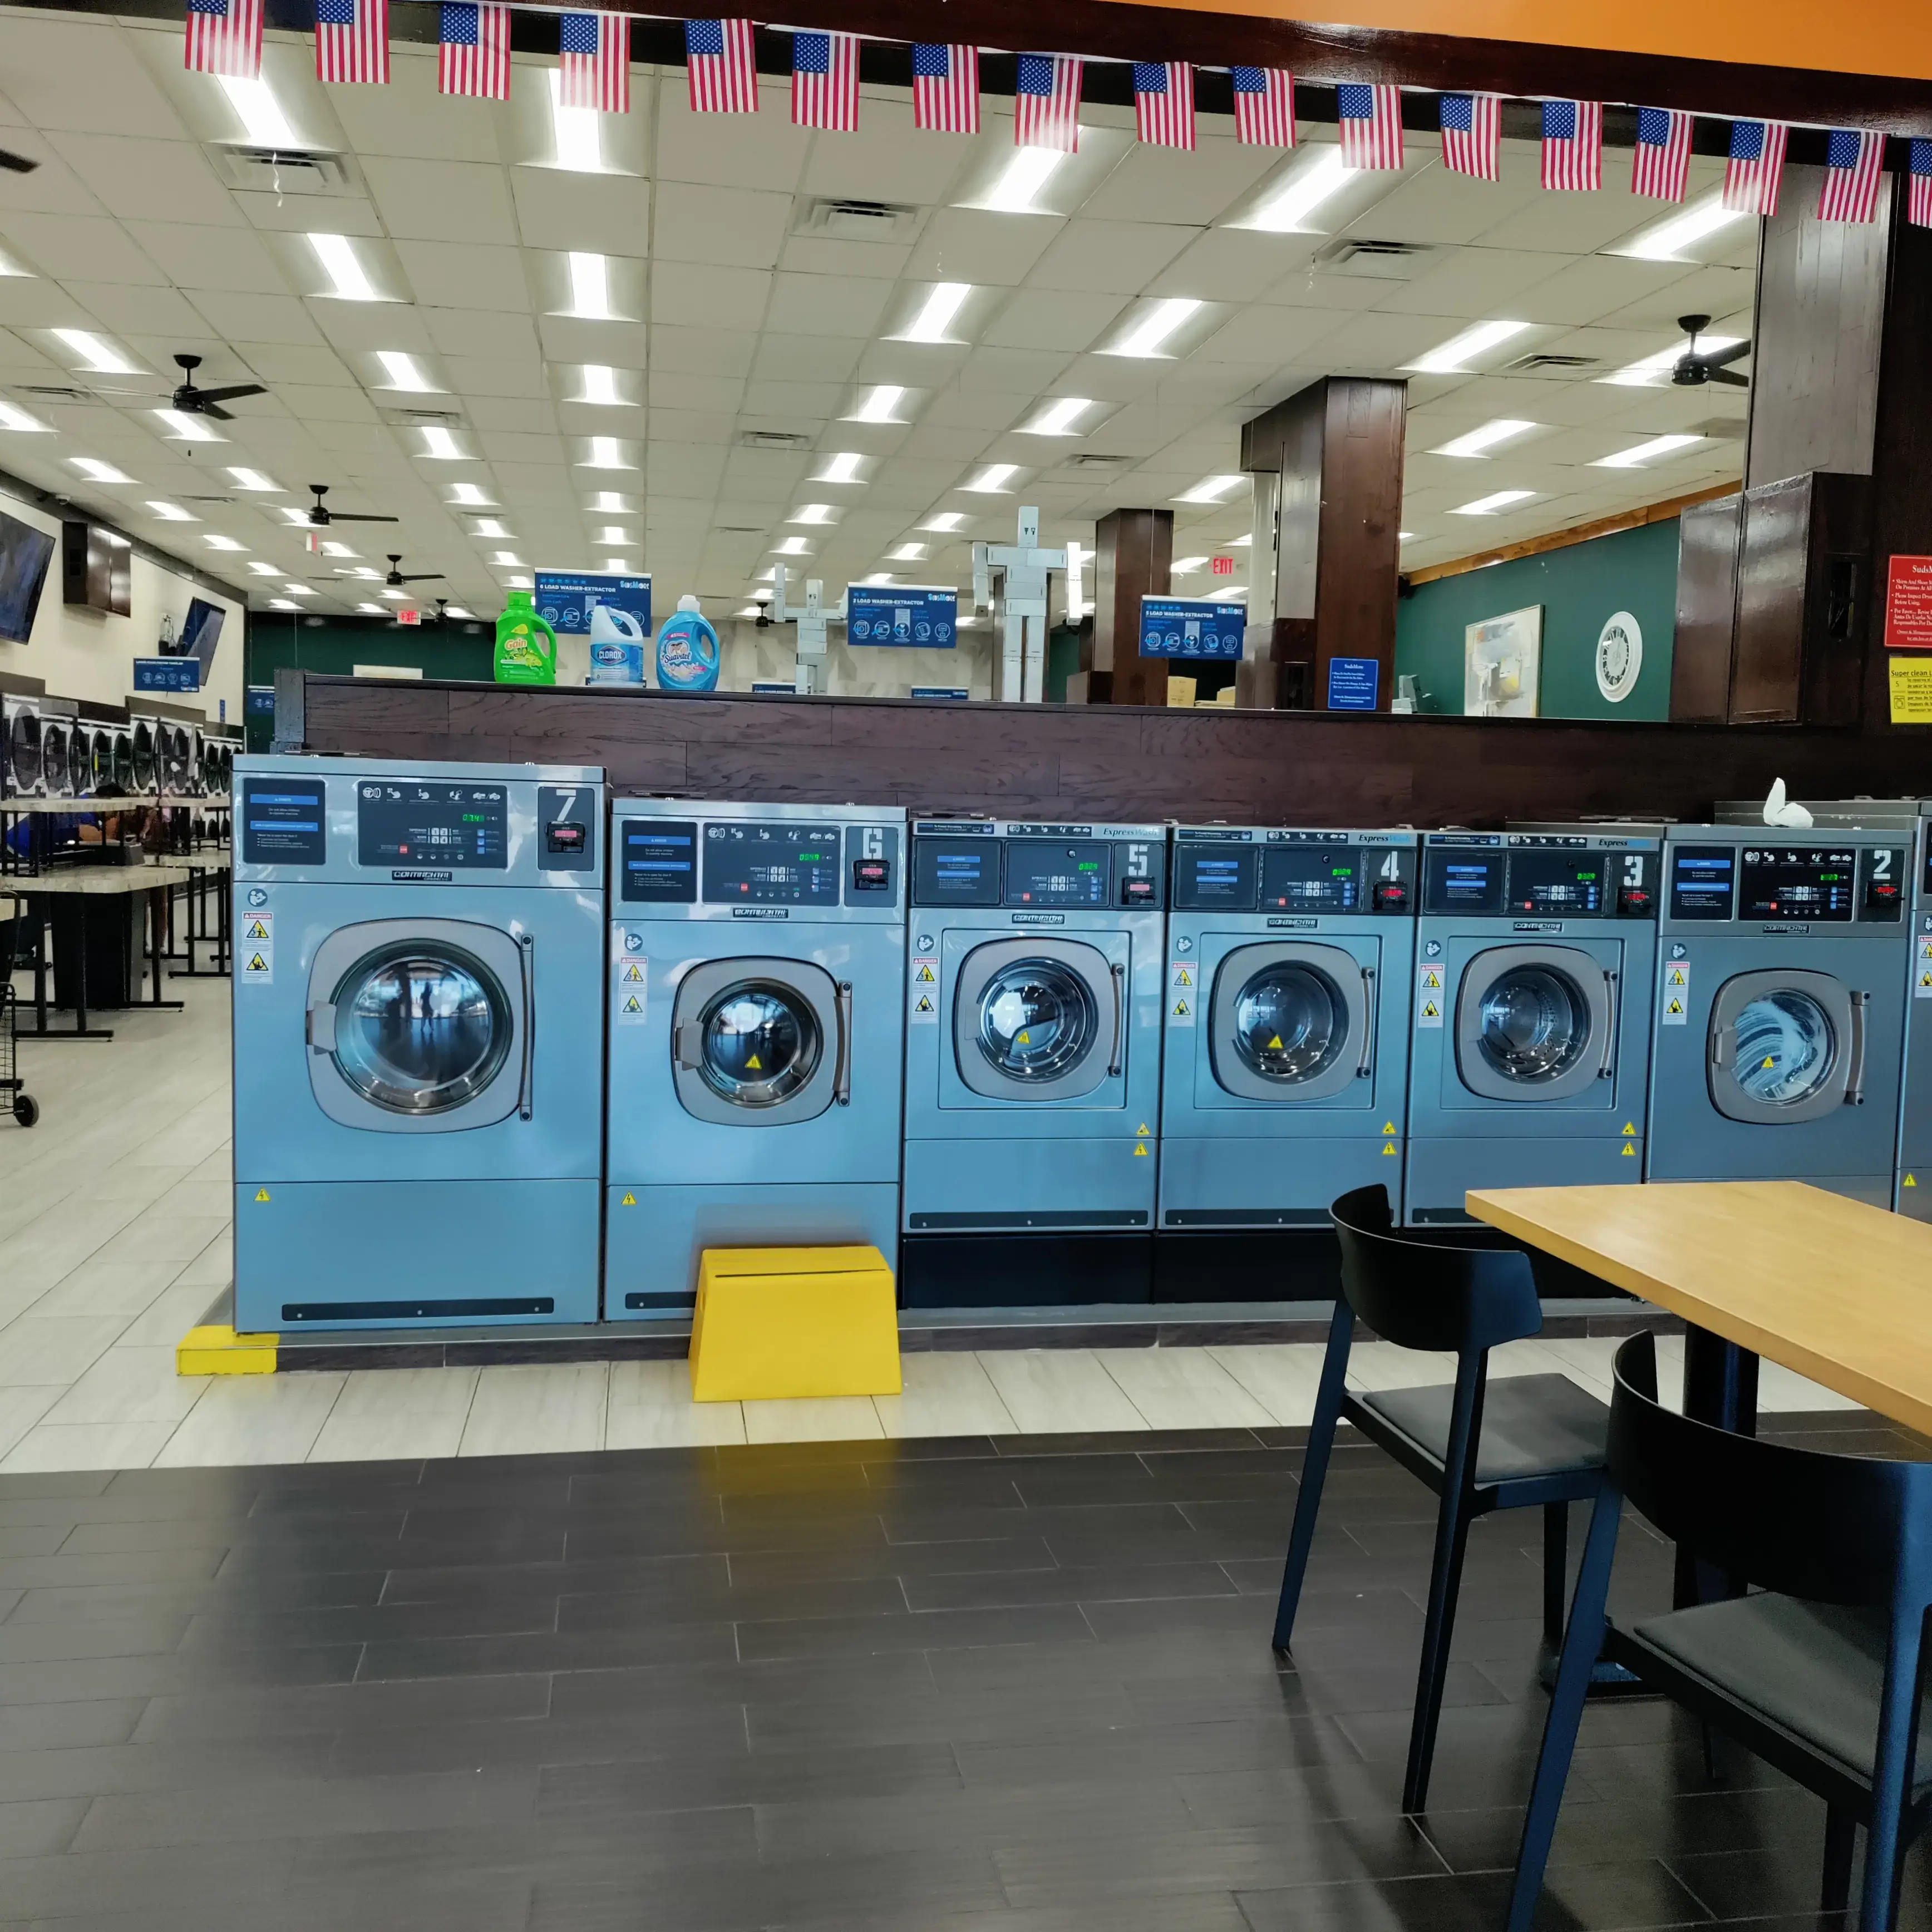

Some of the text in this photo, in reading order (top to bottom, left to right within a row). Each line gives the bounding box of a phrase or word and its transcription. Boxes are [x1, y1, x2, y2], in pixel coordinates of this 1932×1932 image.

[1213, 558, 1233, 574] EXIT
[505, 639, 527, 650] Gain
[599, 650, 622, 659] CLOROX
[664, 653, 691, 663] Suavitel
[556, 789, 576, 821] 7
[1128, 844, 1148, 876] 5
[1381, 851, 1399, 881] 4
[1624, 856, 1643, 886] 3
[1873, 850, 1891, 879] 2
